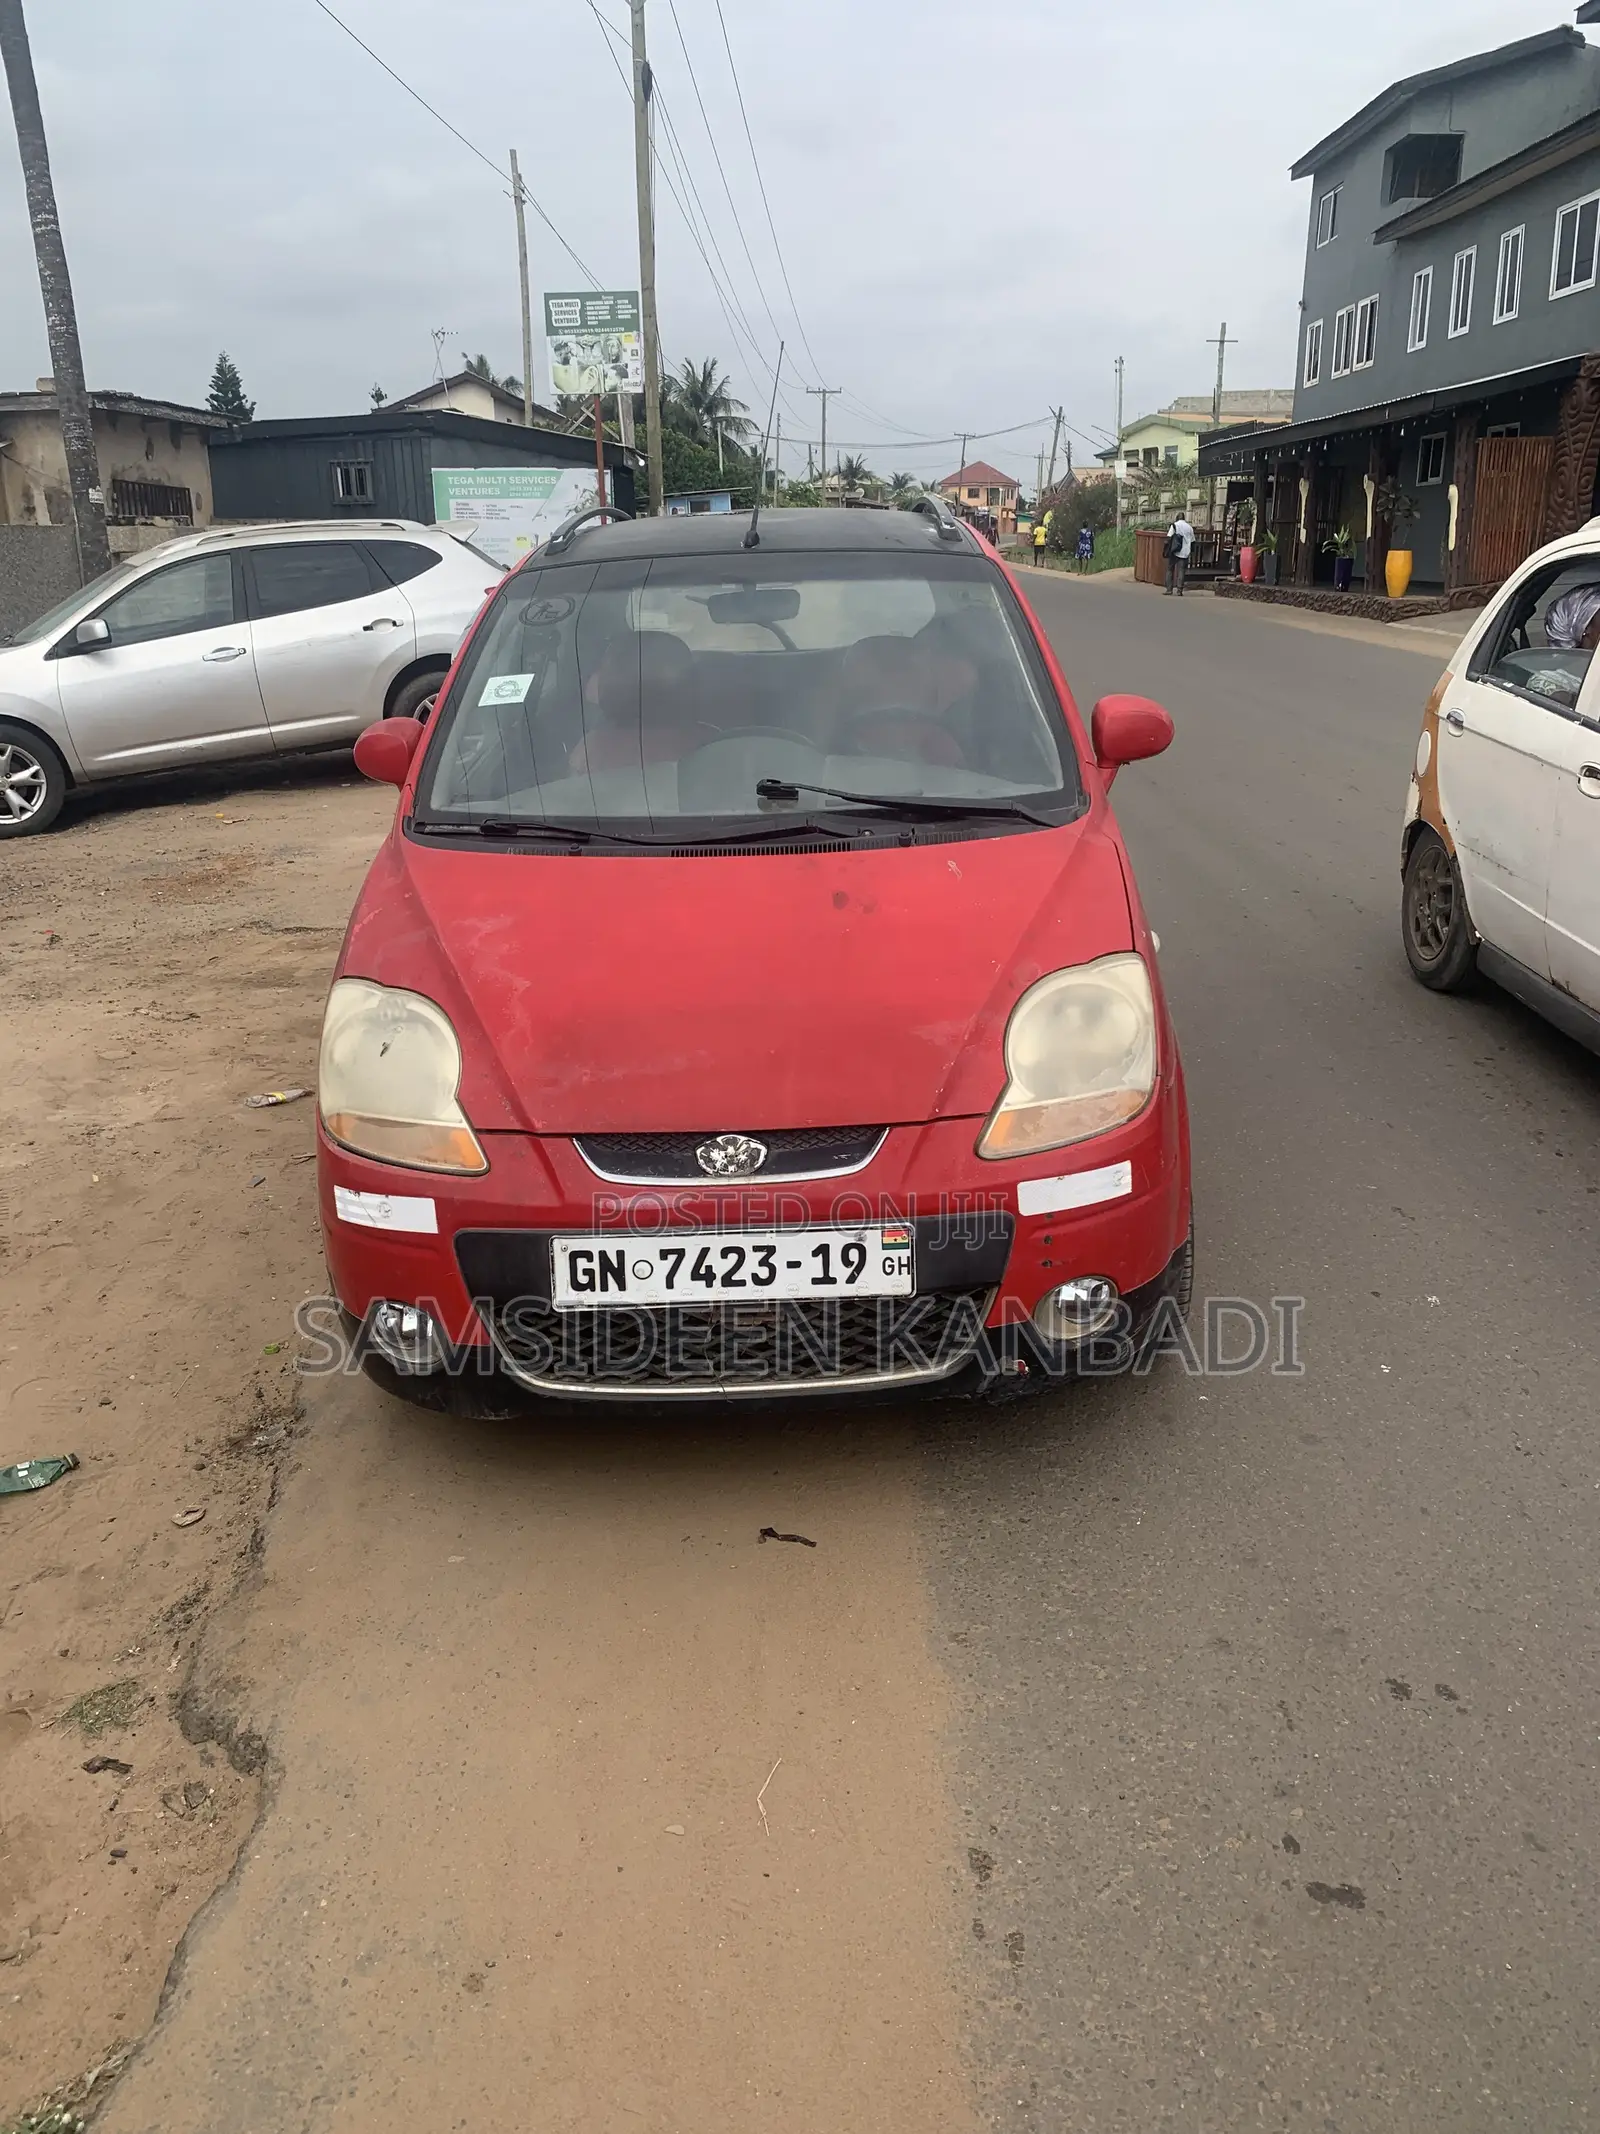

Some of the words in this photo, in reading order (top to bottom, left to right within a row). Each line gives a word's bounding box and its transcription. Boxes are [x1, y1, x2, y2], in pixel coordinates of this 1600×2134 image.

[551, 301, 564, 309] TEGA
[554, 317, 579, 325] VENTURES
[447, 476, 474, 485] TEGA
[476, 476, 506, 484] MULTI
[508, 476, 557, 484] SERVICES
[448, 487, 501, 496] VENTURES
[881, 1255, 911, 1276] GH
[568, 1249, 627, 1292] GN
